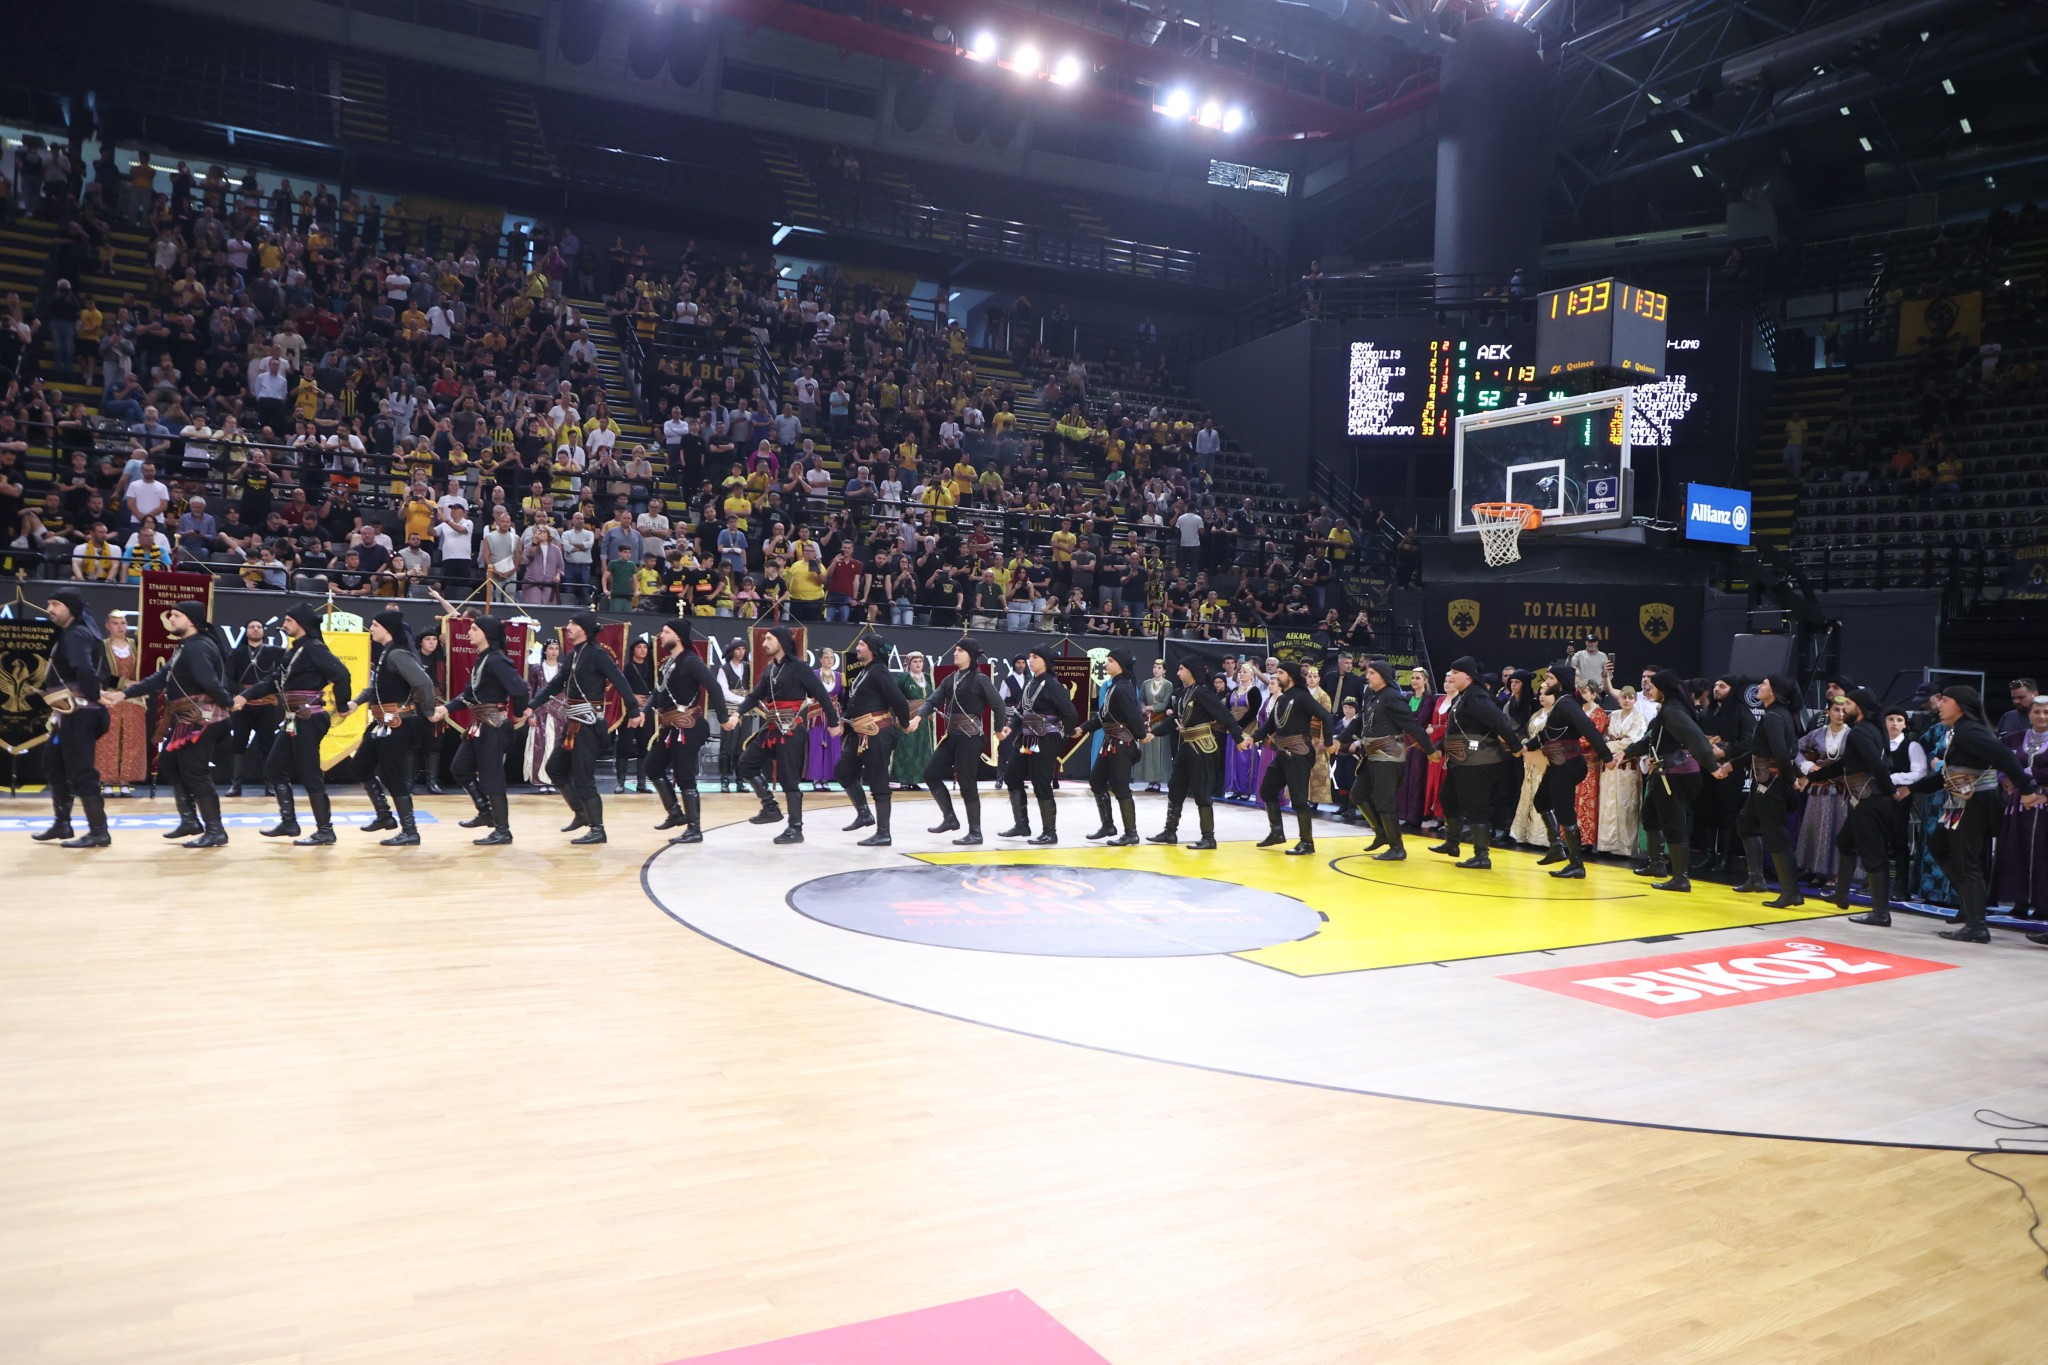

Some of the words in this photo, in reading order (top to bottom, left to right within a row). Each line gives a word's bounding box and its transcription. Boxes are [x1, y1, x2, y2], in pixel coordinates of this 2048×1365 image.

[1551, 282, 1611, 319] 11:33
[1622, 286, 1668, 321] 11:33
[1351, 342, 1374, 351] GRAY
[1430, 341, 1438, 350] 0
[1441, 341, 1450, 351] 2
[1477, 345, 1513, 360] AEK
[1566, 361, 1595, 372] Quince
[1634, 363, 1656, 374] Quince
[1440, 383, 1449, 393] 2
[1478, 390, 1501, 406] 52
[1517, 392, 1528, 406] 2
[1439, 417, 1448, 427] 2
[1421, 426, 1435, 435] 33
[1690, 503, 1731, 524] Allianz
[1524, 602, 1541, 616] ΤΟ
[1547, 602, 1596, 617] ΤΑΞΙΔΙ
[1509, 625, 1609, 640] ΣΥΝΕΧΙΖΕΤΑΙ
